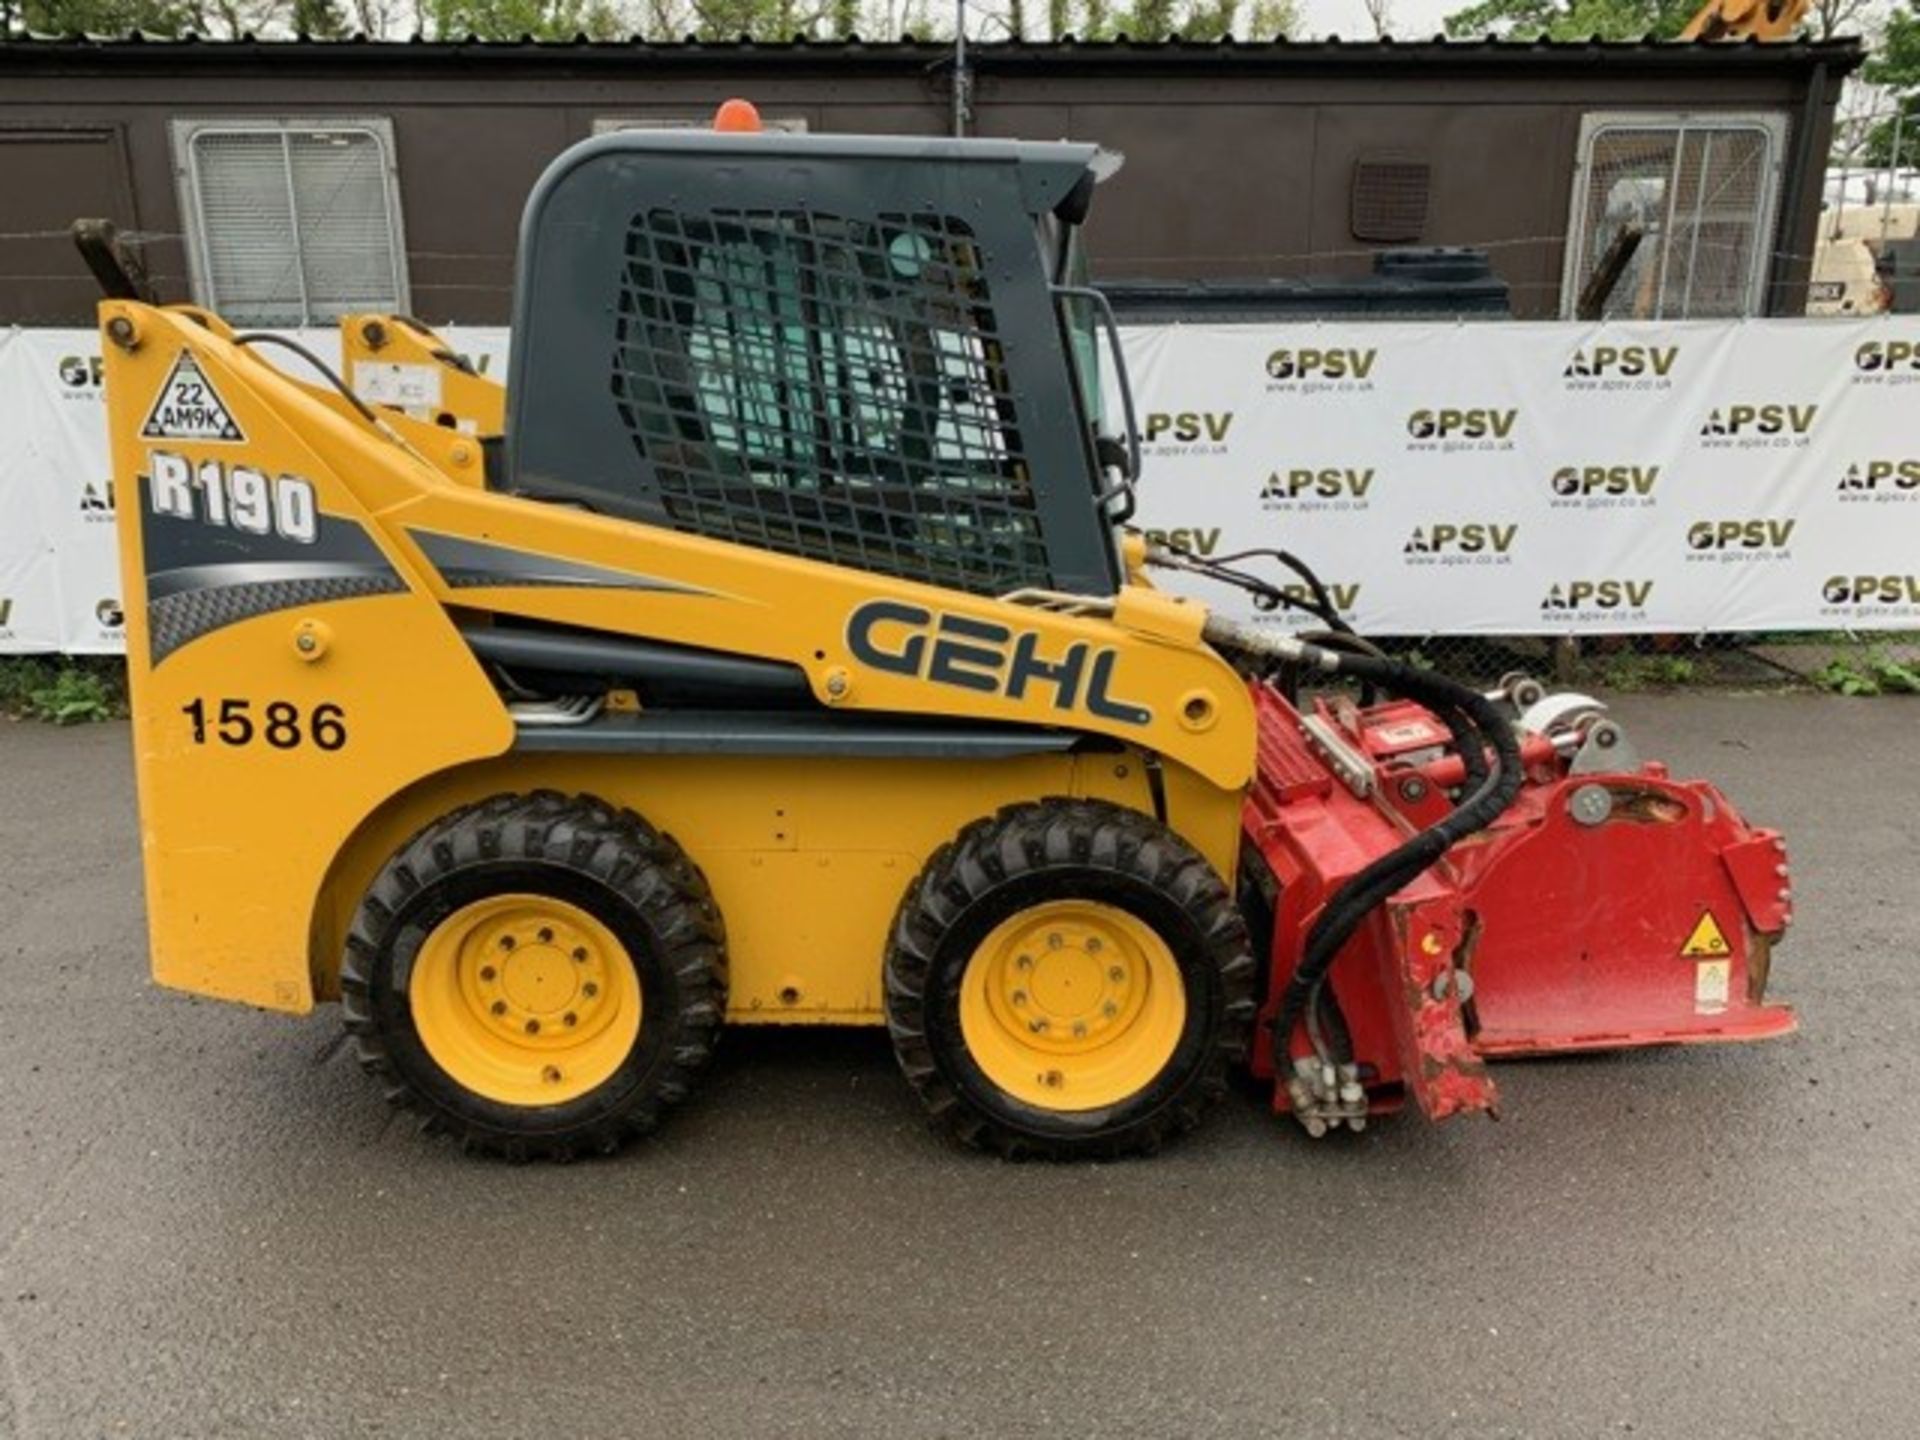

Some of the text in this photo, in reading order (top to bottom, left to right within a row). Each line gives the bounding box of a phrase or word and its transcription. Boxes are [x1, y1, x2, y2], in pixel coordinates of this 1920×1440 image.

[1265, 348, 1377, 379] GPSV
[1563, 347, 1678, 377] APSV
[175, 383, 204, 406] 22
[163, 407, 220, 430] AM9K
[1407, 408, 1518, 438] GPSV
[1700, 405, 1818, 436] APSV
[1259, 468, 1374, 498] APSV
[1552, 466, 1659, 496] GPSV
[149, 449, 318, 544] R190
[1403, 524, 1518, 552] APSV
[1687, 519, 1795, 550] GPSV
[1540, 580, 1653, 609] APSV
[846, 601, 1152, 725] GEHL
[182, 697, 346, 751] 1586
